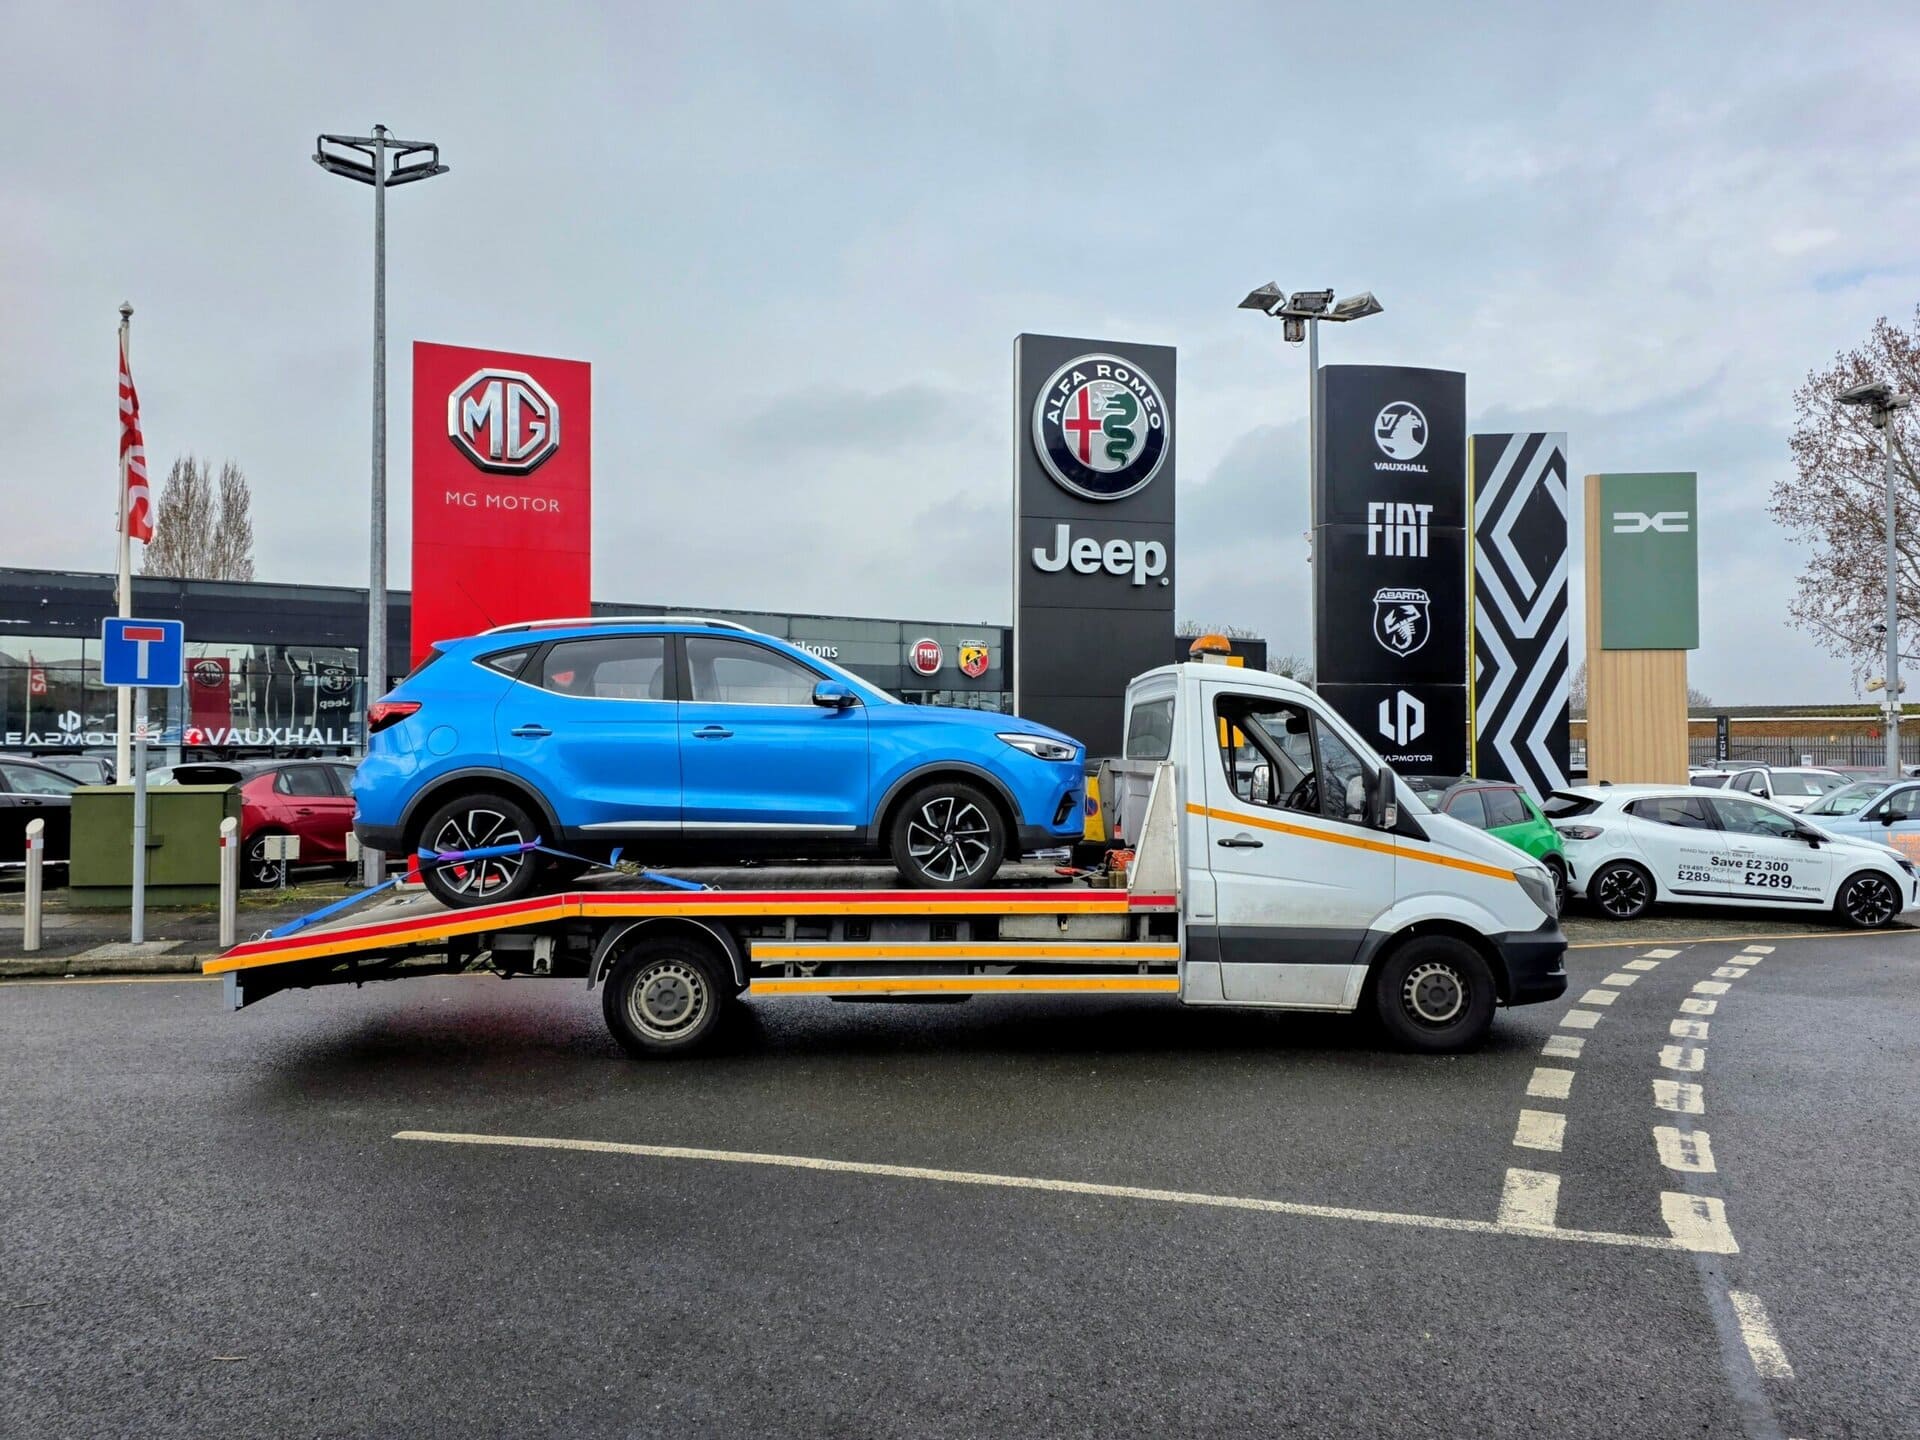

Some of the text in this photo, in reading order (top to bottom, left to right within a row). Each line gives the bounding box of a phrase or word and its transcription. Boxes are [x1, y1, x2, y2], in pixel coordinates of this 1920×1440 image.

[1047, 364, 1161, 430] ALFA ROMEO
[463, 381, 546, 460] MG
[1374, 462, 1429, 473] VAUXHALL
[446, 491, 560, 512] MG MOTOR
[1368, 502, 1433, 557] FIAT
[1033, 524, 1167, 585] Jeep
[1379, 591, 1425, 601] ABARTH
[204, 727, 357, 745] VAUXHALL
[1711, 856, 1743, 868] Save
[1678, 870, 1710, 882] £289
[1744, 872, 1792, 888] £289
